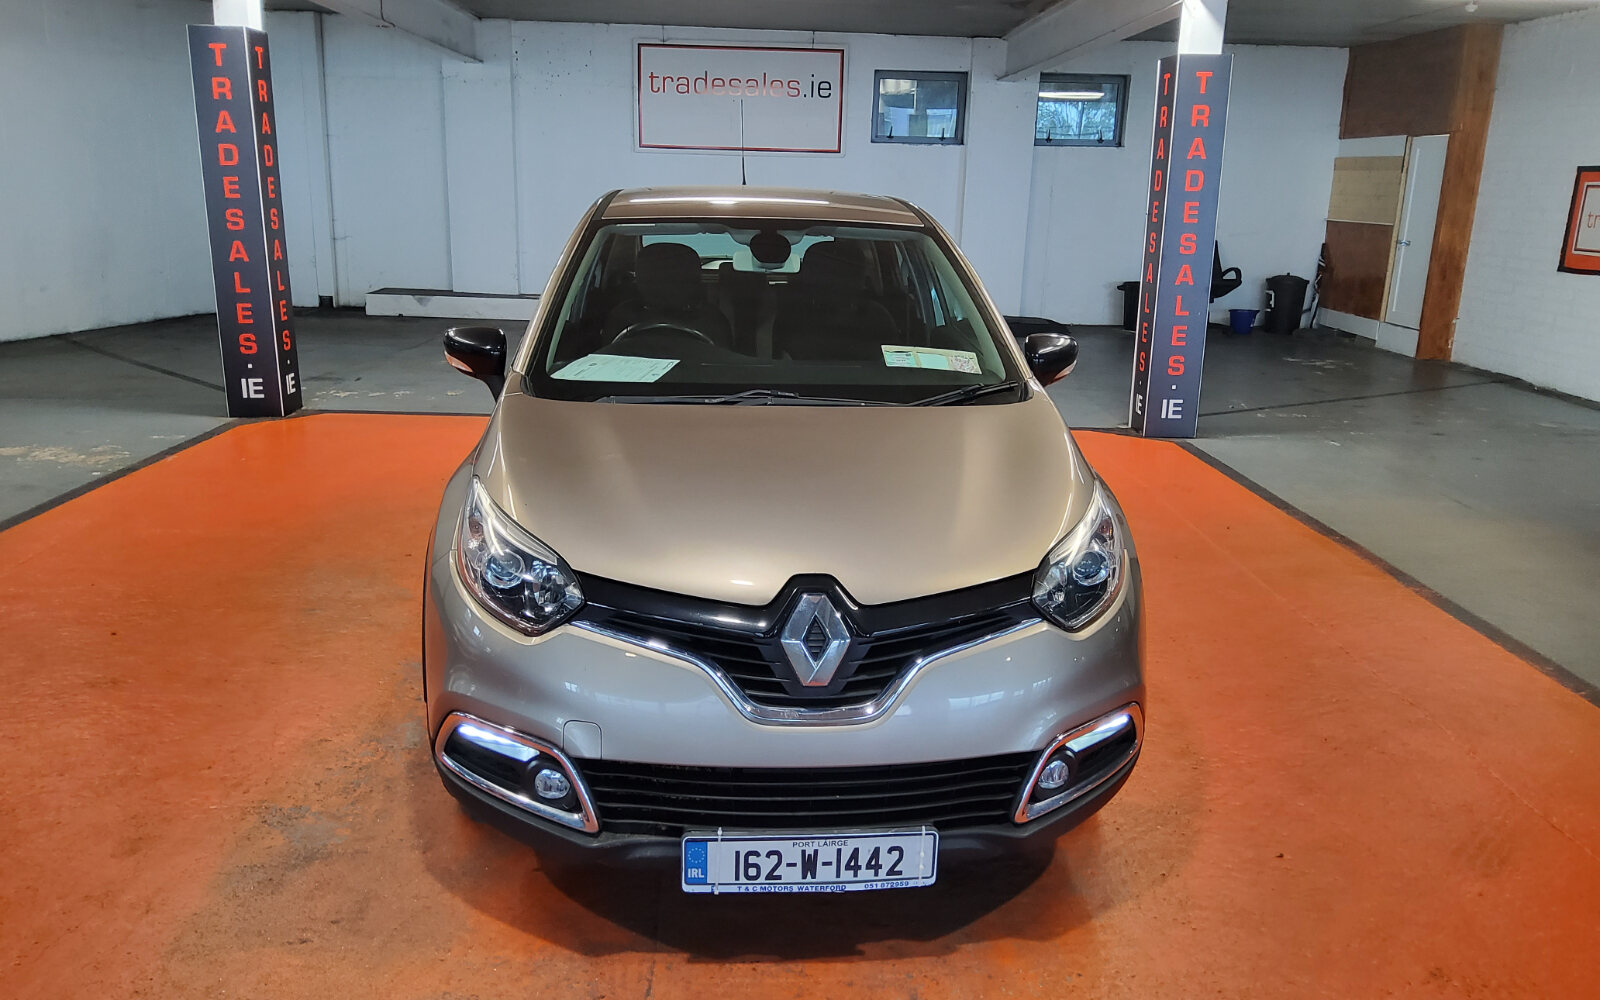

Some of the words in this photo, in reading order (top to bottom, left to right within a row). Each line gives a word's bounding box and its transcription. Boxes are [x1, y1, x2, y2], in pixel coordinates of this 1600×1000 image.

[648, 70, 832, 99] tradesales.ie
[687, 868, 705, 878] IRL
[734, 846, 904, 881] 162-W-1442
